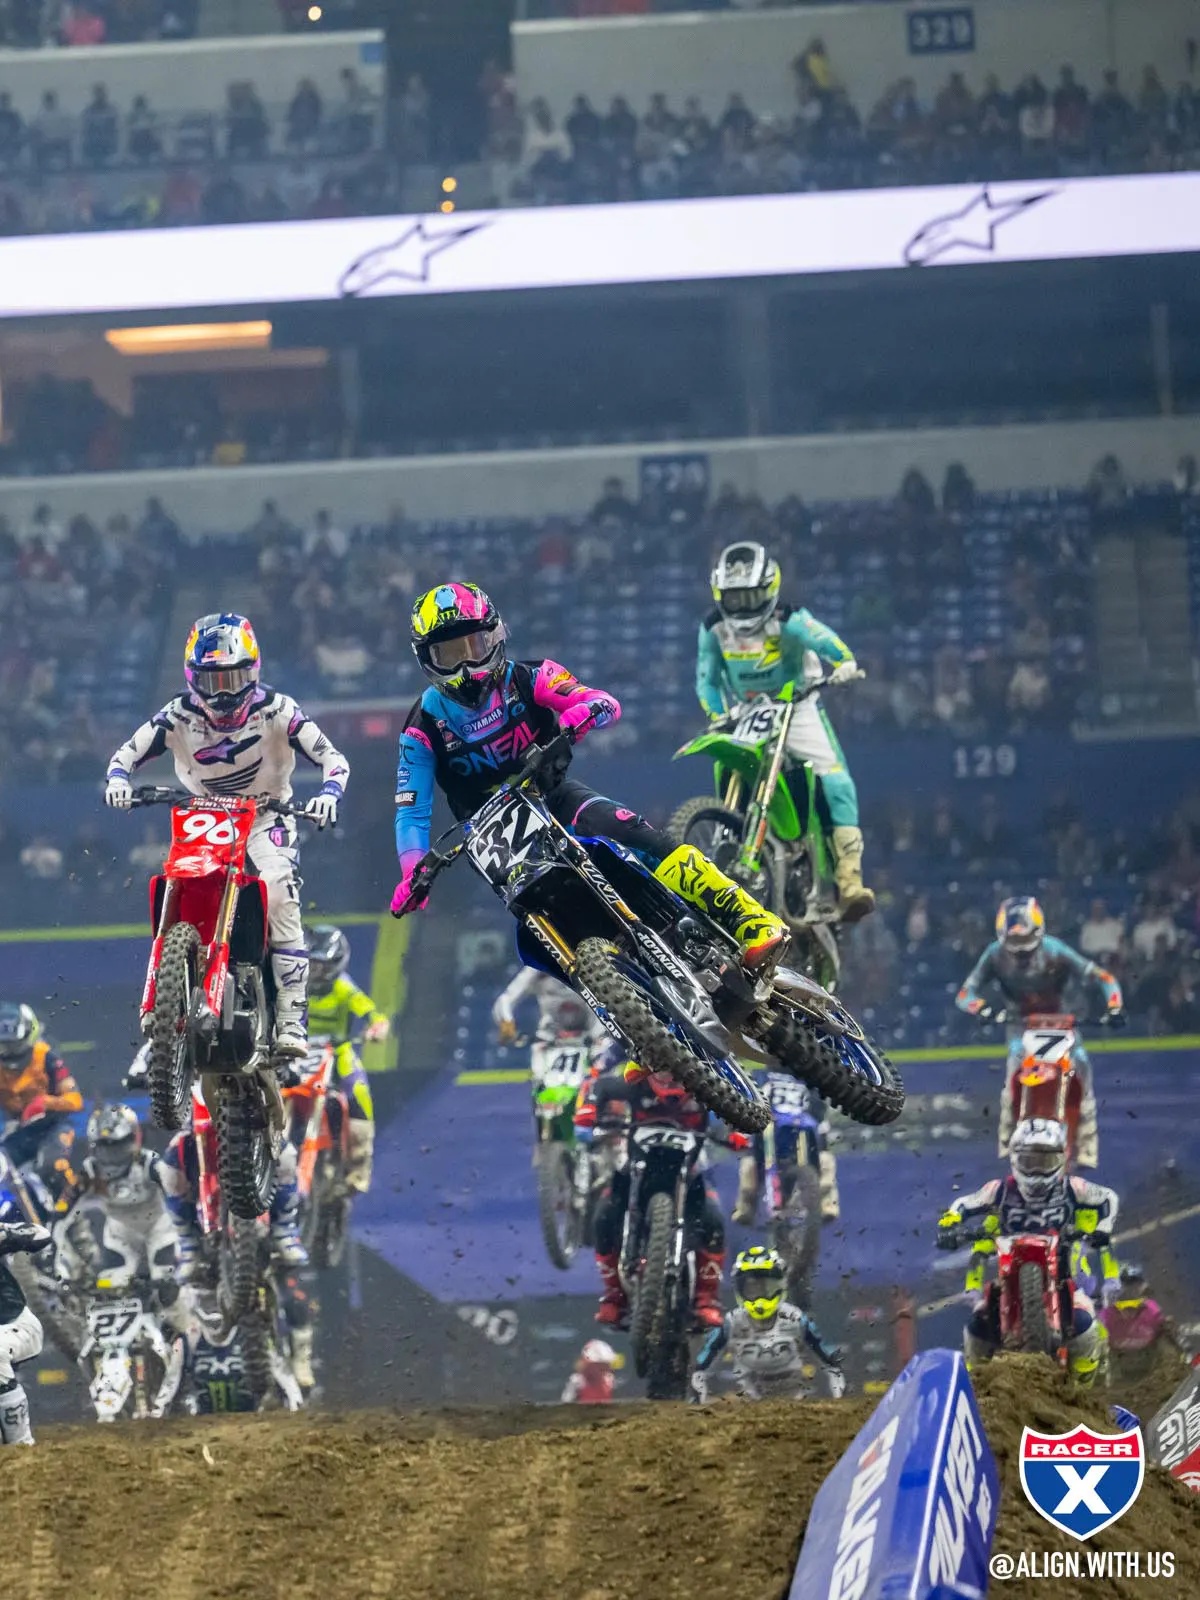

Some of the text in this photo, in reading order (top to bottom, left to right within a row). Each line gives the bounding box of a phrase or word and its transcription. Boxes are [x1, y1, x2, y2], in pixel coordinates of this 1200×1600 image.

[471, 706, 503, 732] YAMAHA
[743, 708, 778, 736] 19
[953, 744, 1017, 778] 129
[183, 813, 241, 845] 96
[474, 800, 542, 878] 32
[637, 931, 686, 979] DUNLOP
[1035, 1034, 1066, 1059] 7
[552, 1051, 582, 1074] 41
[92, 1311, 139, 1338] 27
